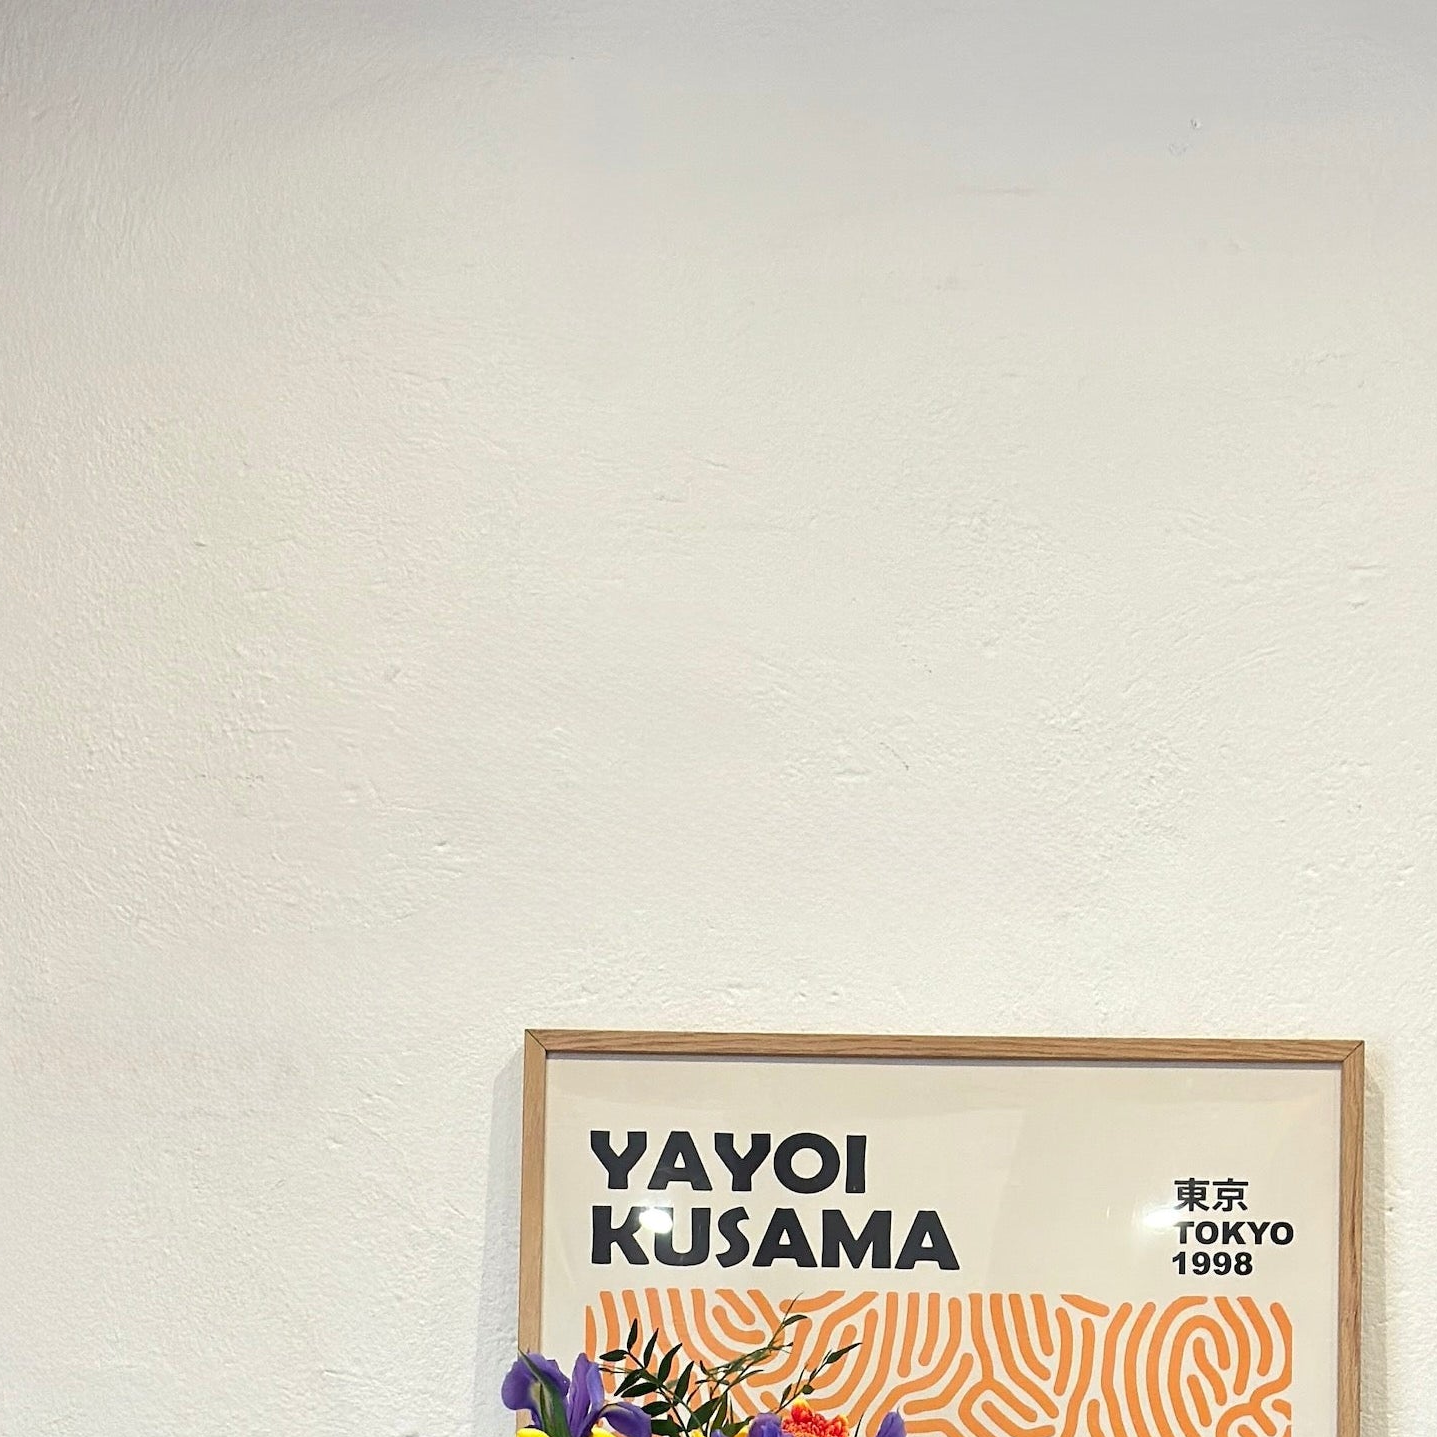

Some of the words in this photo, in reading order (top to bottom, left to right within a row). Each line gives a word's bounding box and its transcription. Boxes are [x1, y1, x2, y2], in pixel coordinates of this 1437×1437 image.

[590, 1130, 866, 1194] YAYOI
[1173, 1177, 1249, 1212] 東京
[591, 1205, 960, 1270] KUSAMA
[1173, 1221, 1294, 1245] TOKYO
[1172, 1251, 1253, 1276] 1998
